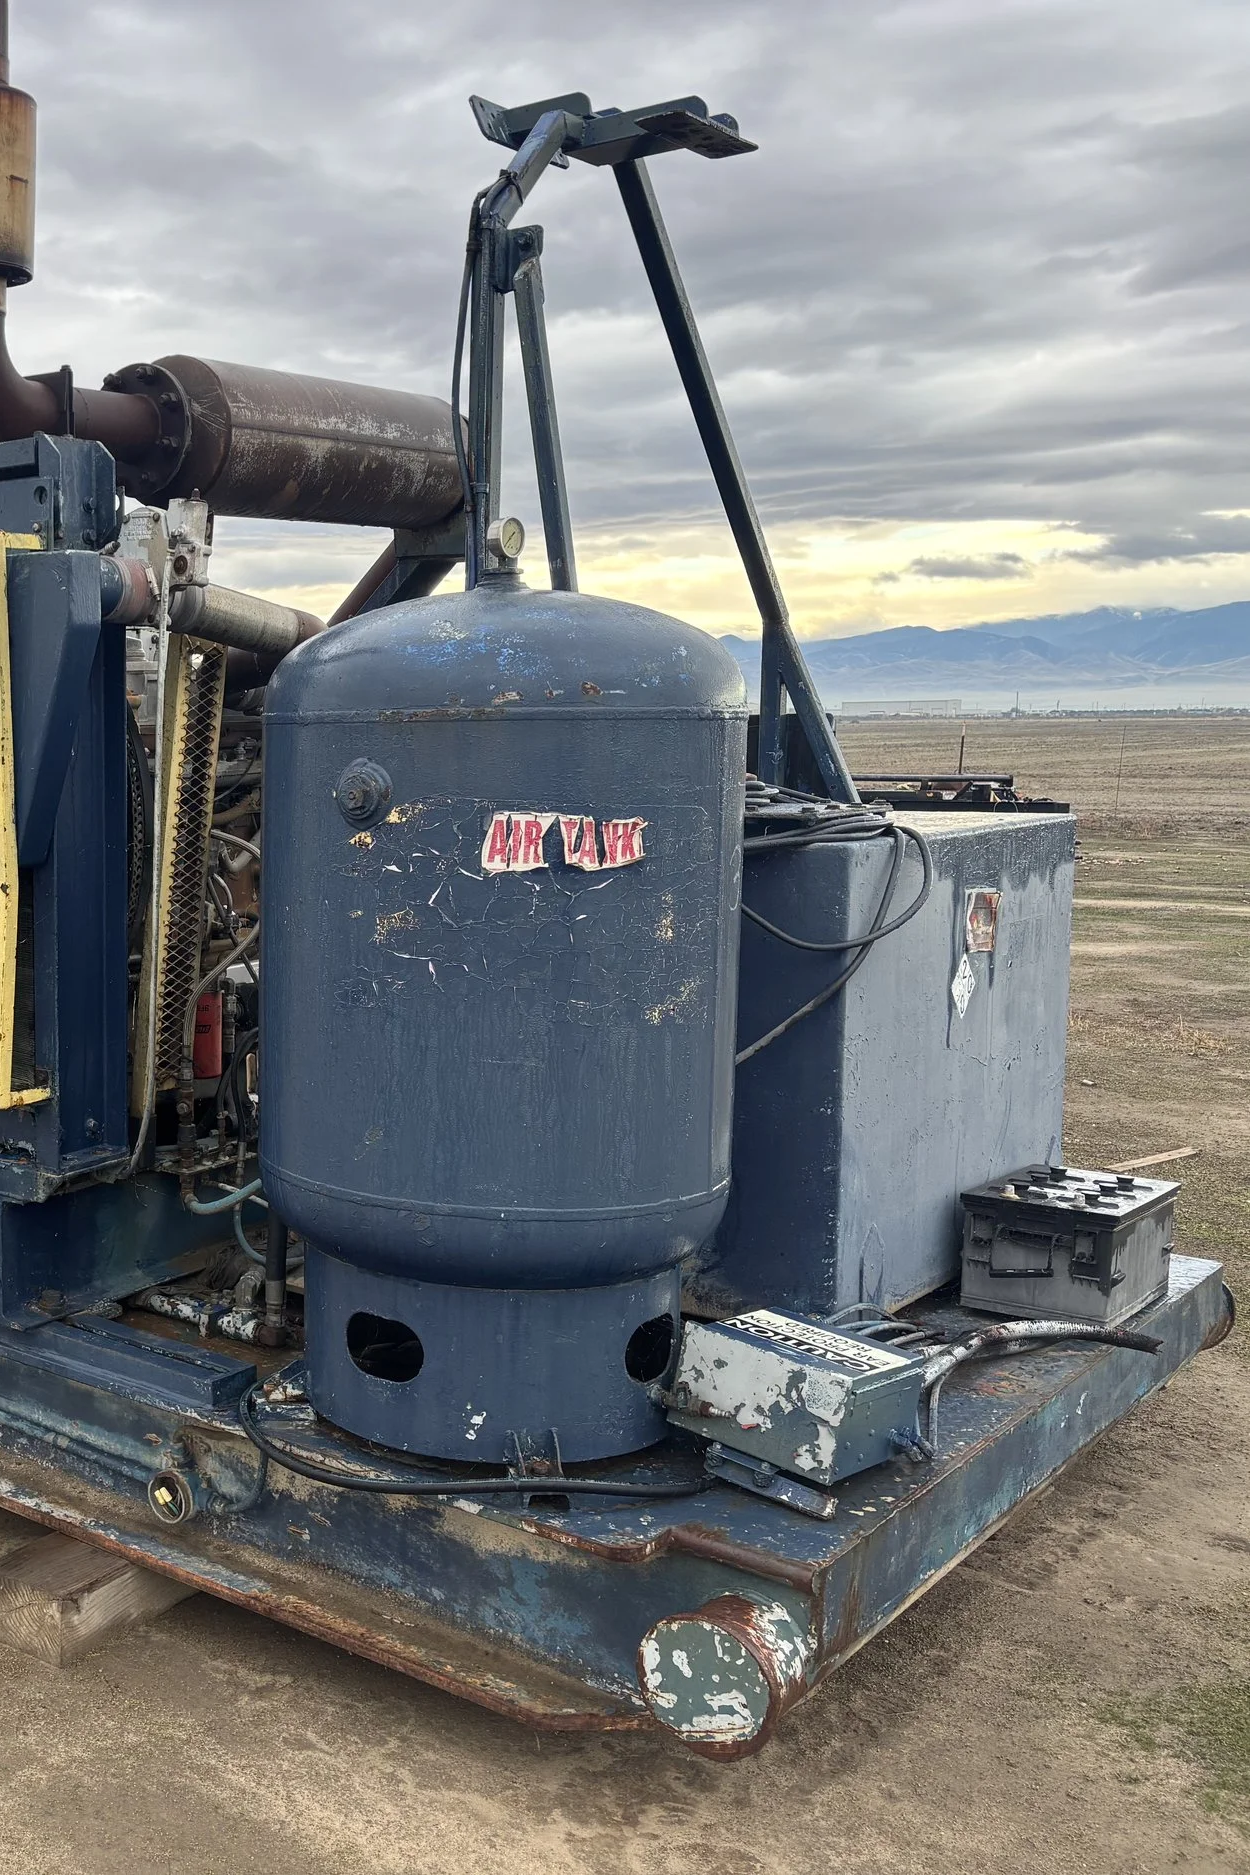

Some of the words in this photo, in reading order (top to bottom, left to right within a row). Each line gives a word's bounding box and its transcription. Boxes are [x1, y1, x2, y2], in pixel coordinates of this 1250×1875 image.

[487, 820, 543, 863] AIR
[561, 820, 640, 864] TANK
[963, 960, 967, 979] 2
[723, 1319, 872, 1371] CAUTION
[743, 1315, 849, 1352] PROTECTION
[785, 1322, 872, 1352] REQUIRED
[851, 1352, 891, 1367] EAR
